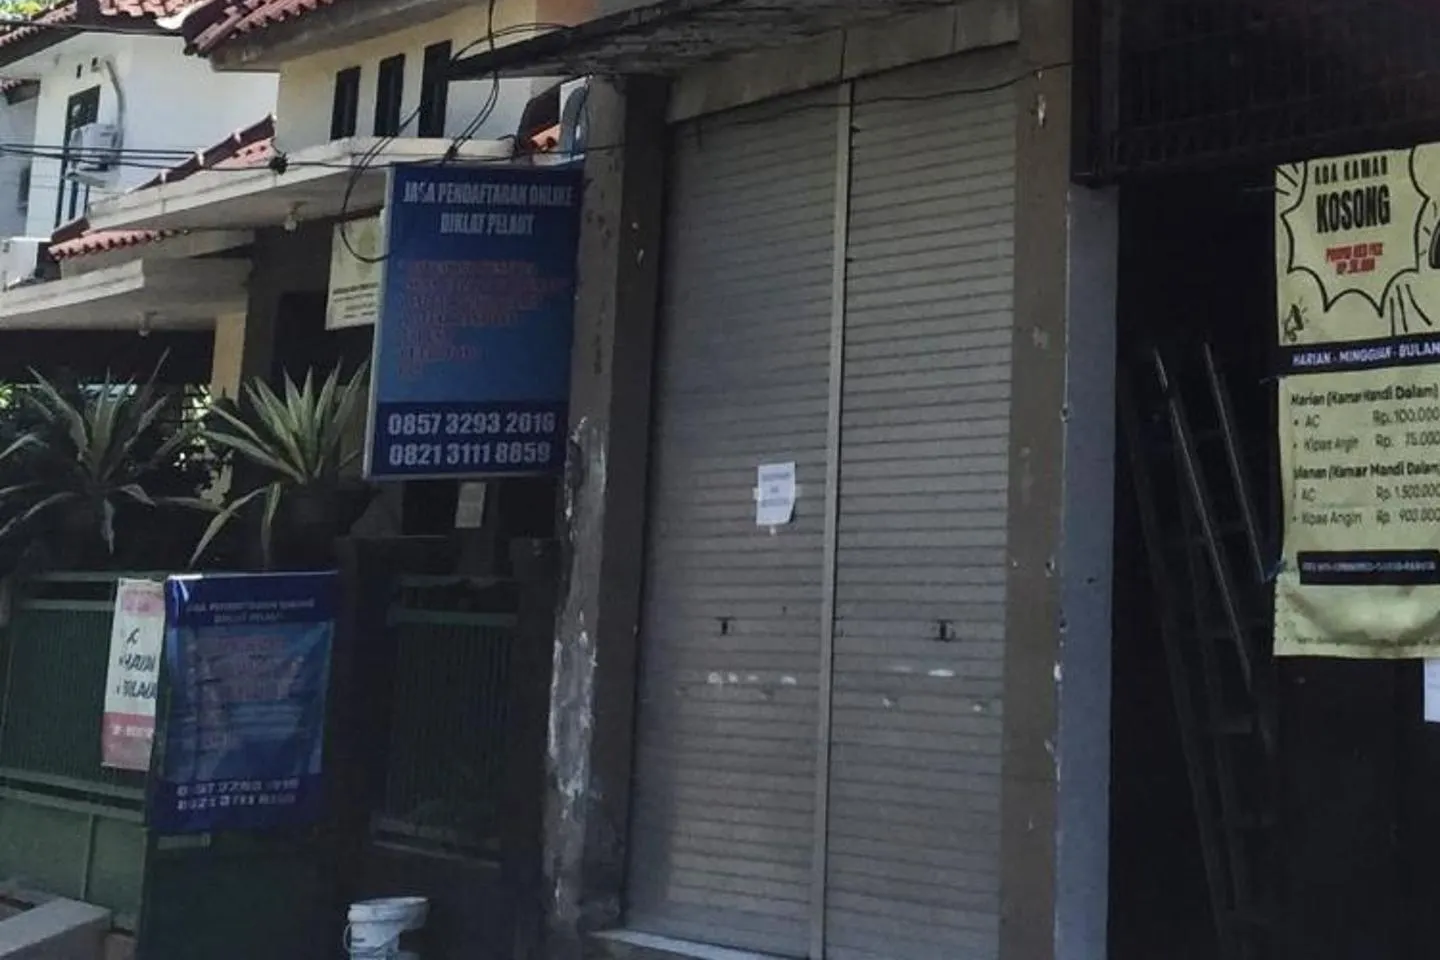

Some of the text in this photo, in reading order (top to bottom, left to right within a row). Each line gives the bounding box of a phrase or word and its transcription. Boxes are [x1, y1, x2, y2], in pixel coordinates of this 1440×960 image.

[403, 180, 436, 203] JASA
[1316, 183, 1391, 234] KOSONG
[1291, 351, 1332, 367] HARIAN
[1338, 344, 1392, 362] MINGGUAN
[387, 412, 442, 436] 0857
[445, 411, 501, 435] 3293
[1305, 414, 1320, 428] AC
[388, 443, 442, 466] 0821
[446, 442, 492, 464] 3111
